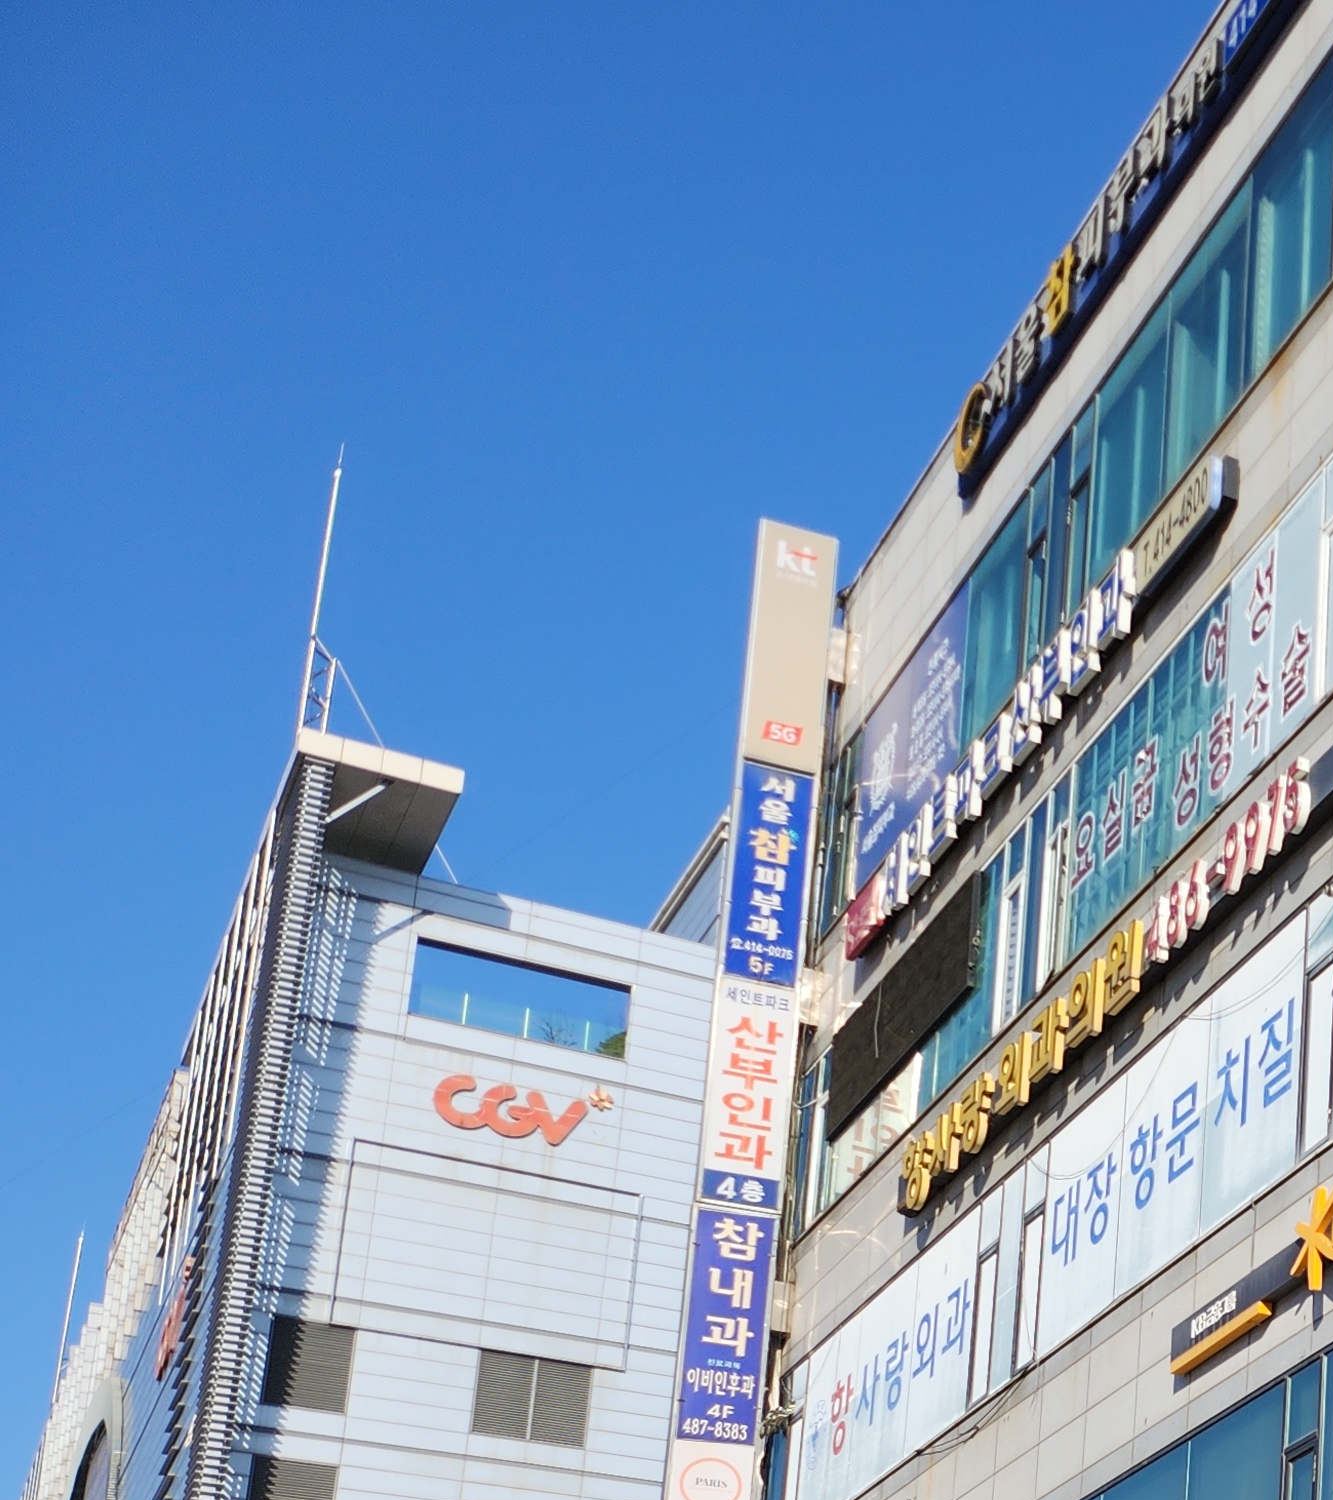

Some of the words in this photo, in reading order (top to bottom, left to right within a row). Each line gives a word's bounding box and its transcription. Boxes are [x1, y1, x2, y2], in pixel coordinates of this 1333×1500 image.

[777, 540, 818, 577] kt
[769, 722, 797, 744] 5G
[1071, 735, 1158, 891] 요실금
[1175, 622, 1311, 829] 성형수술
[749, 956, 774, 976] 5F
[725, 985, 790, 1012] 세인트파크
[1214, 996, 1295, 1127] 치질
[714, 1012, 785, 1173] 산부인과
[433, 1074, 589, 1146] CGV
[715, 1173, 766, 1205] 4층
[701, 1216, 765, 1361] 참내과
[686, 1367, 756, 1400] 이비인후과
[706, 1404, 735, 1419] 4F
[682, 1417, 748, 1441] 487-8383
[695, 1477, 728, 1490] PARIS
